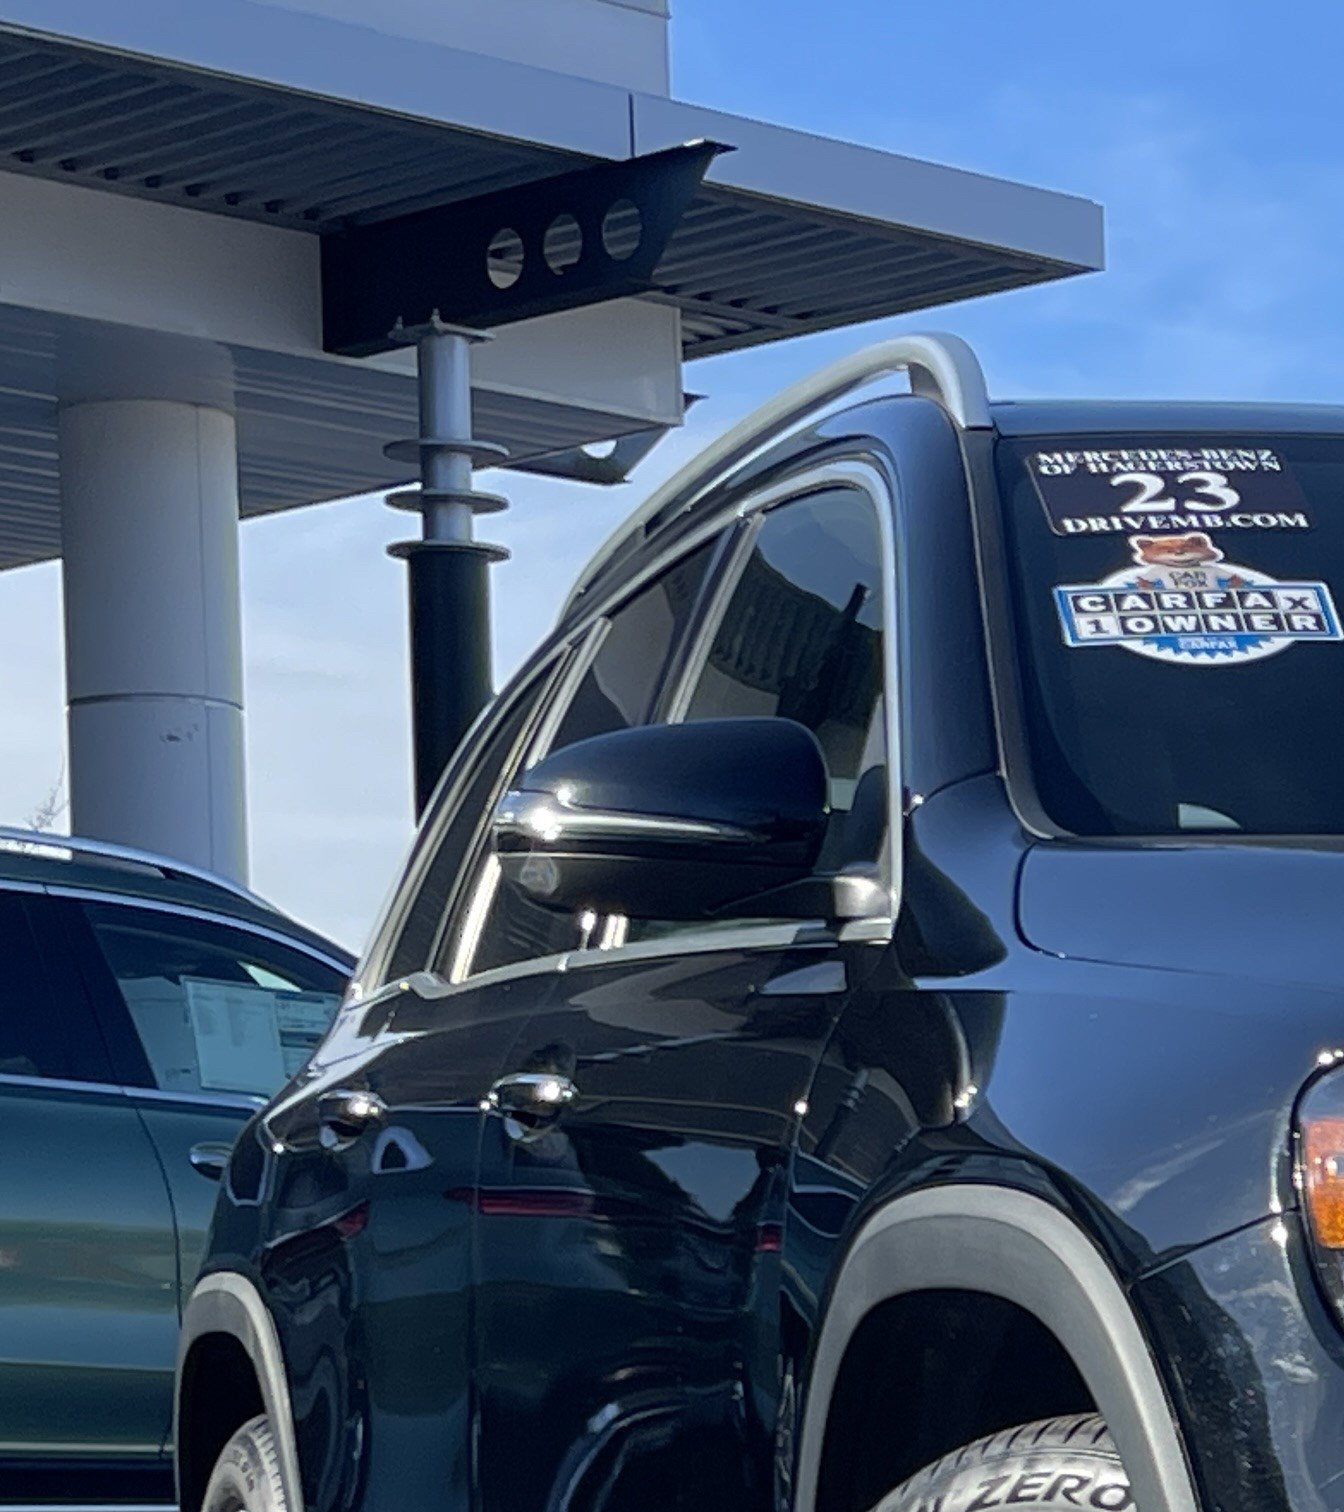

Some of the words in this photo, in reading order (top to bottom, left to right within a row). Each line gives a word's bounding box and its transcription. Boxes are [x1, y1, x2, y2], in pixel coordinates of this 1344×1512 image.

[1111, 471, 1241, 513] 23
[1062, 512, 1310, 533] DRIVEMB.COM
[1076, 592, 1319, 612] CARFAX
[1086, 617, 1111, 635] 1
[1125, 613, 1320, 633] OWNER
